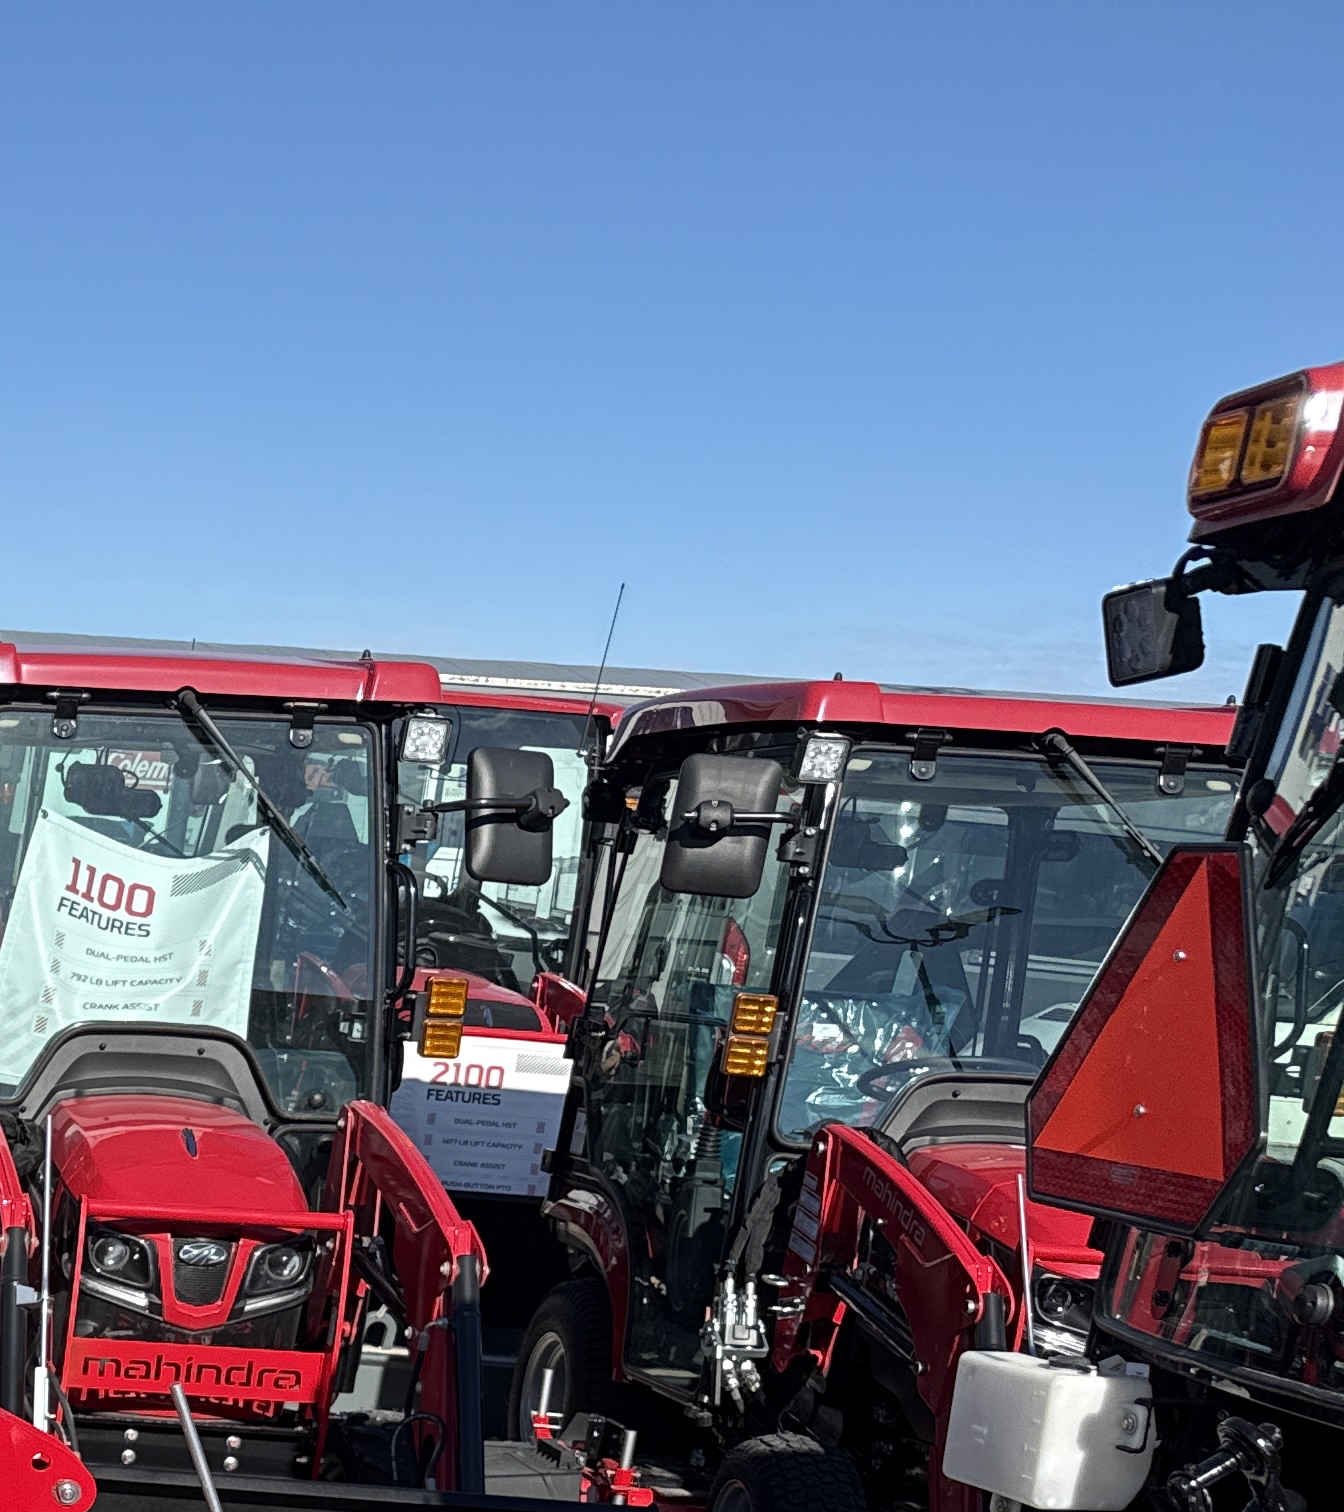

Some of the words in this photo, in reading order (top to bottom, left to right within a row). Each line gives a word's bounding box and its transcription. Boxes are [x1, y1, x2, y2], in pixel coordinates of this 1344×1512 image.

[107, 752, 169, 779] Colem
[64, 856, 156, 919] 1100
[56, 896, 152, 938] FEATURES
[85, 947, 152, 964] DUAL-PEDAL
[154, 952, 174, 964] HST
[89, 975, 103, 986] LB
[105, 977, 128, 987] LIFT
[130, 976, 183, 987] CAPACITY
[83, 1001, 120, 1011] CRANK
[429, 1061, 506, 1090] 2100
[426, 1088, 502, 1106] FEATURES
[453, 1117, 501, 1128] DUAL-PEDAL
[501, 1121, 518, 1129] HST
[470, 1139, 486, 1148] LIFT
[486, 1141, 524, 1151] CAPACITY
[453, 1159, 479, 1168] CRANK
[480, 1161, 506, 1171] ASSIST
[81, 1353, 299, 1391] mahindra
